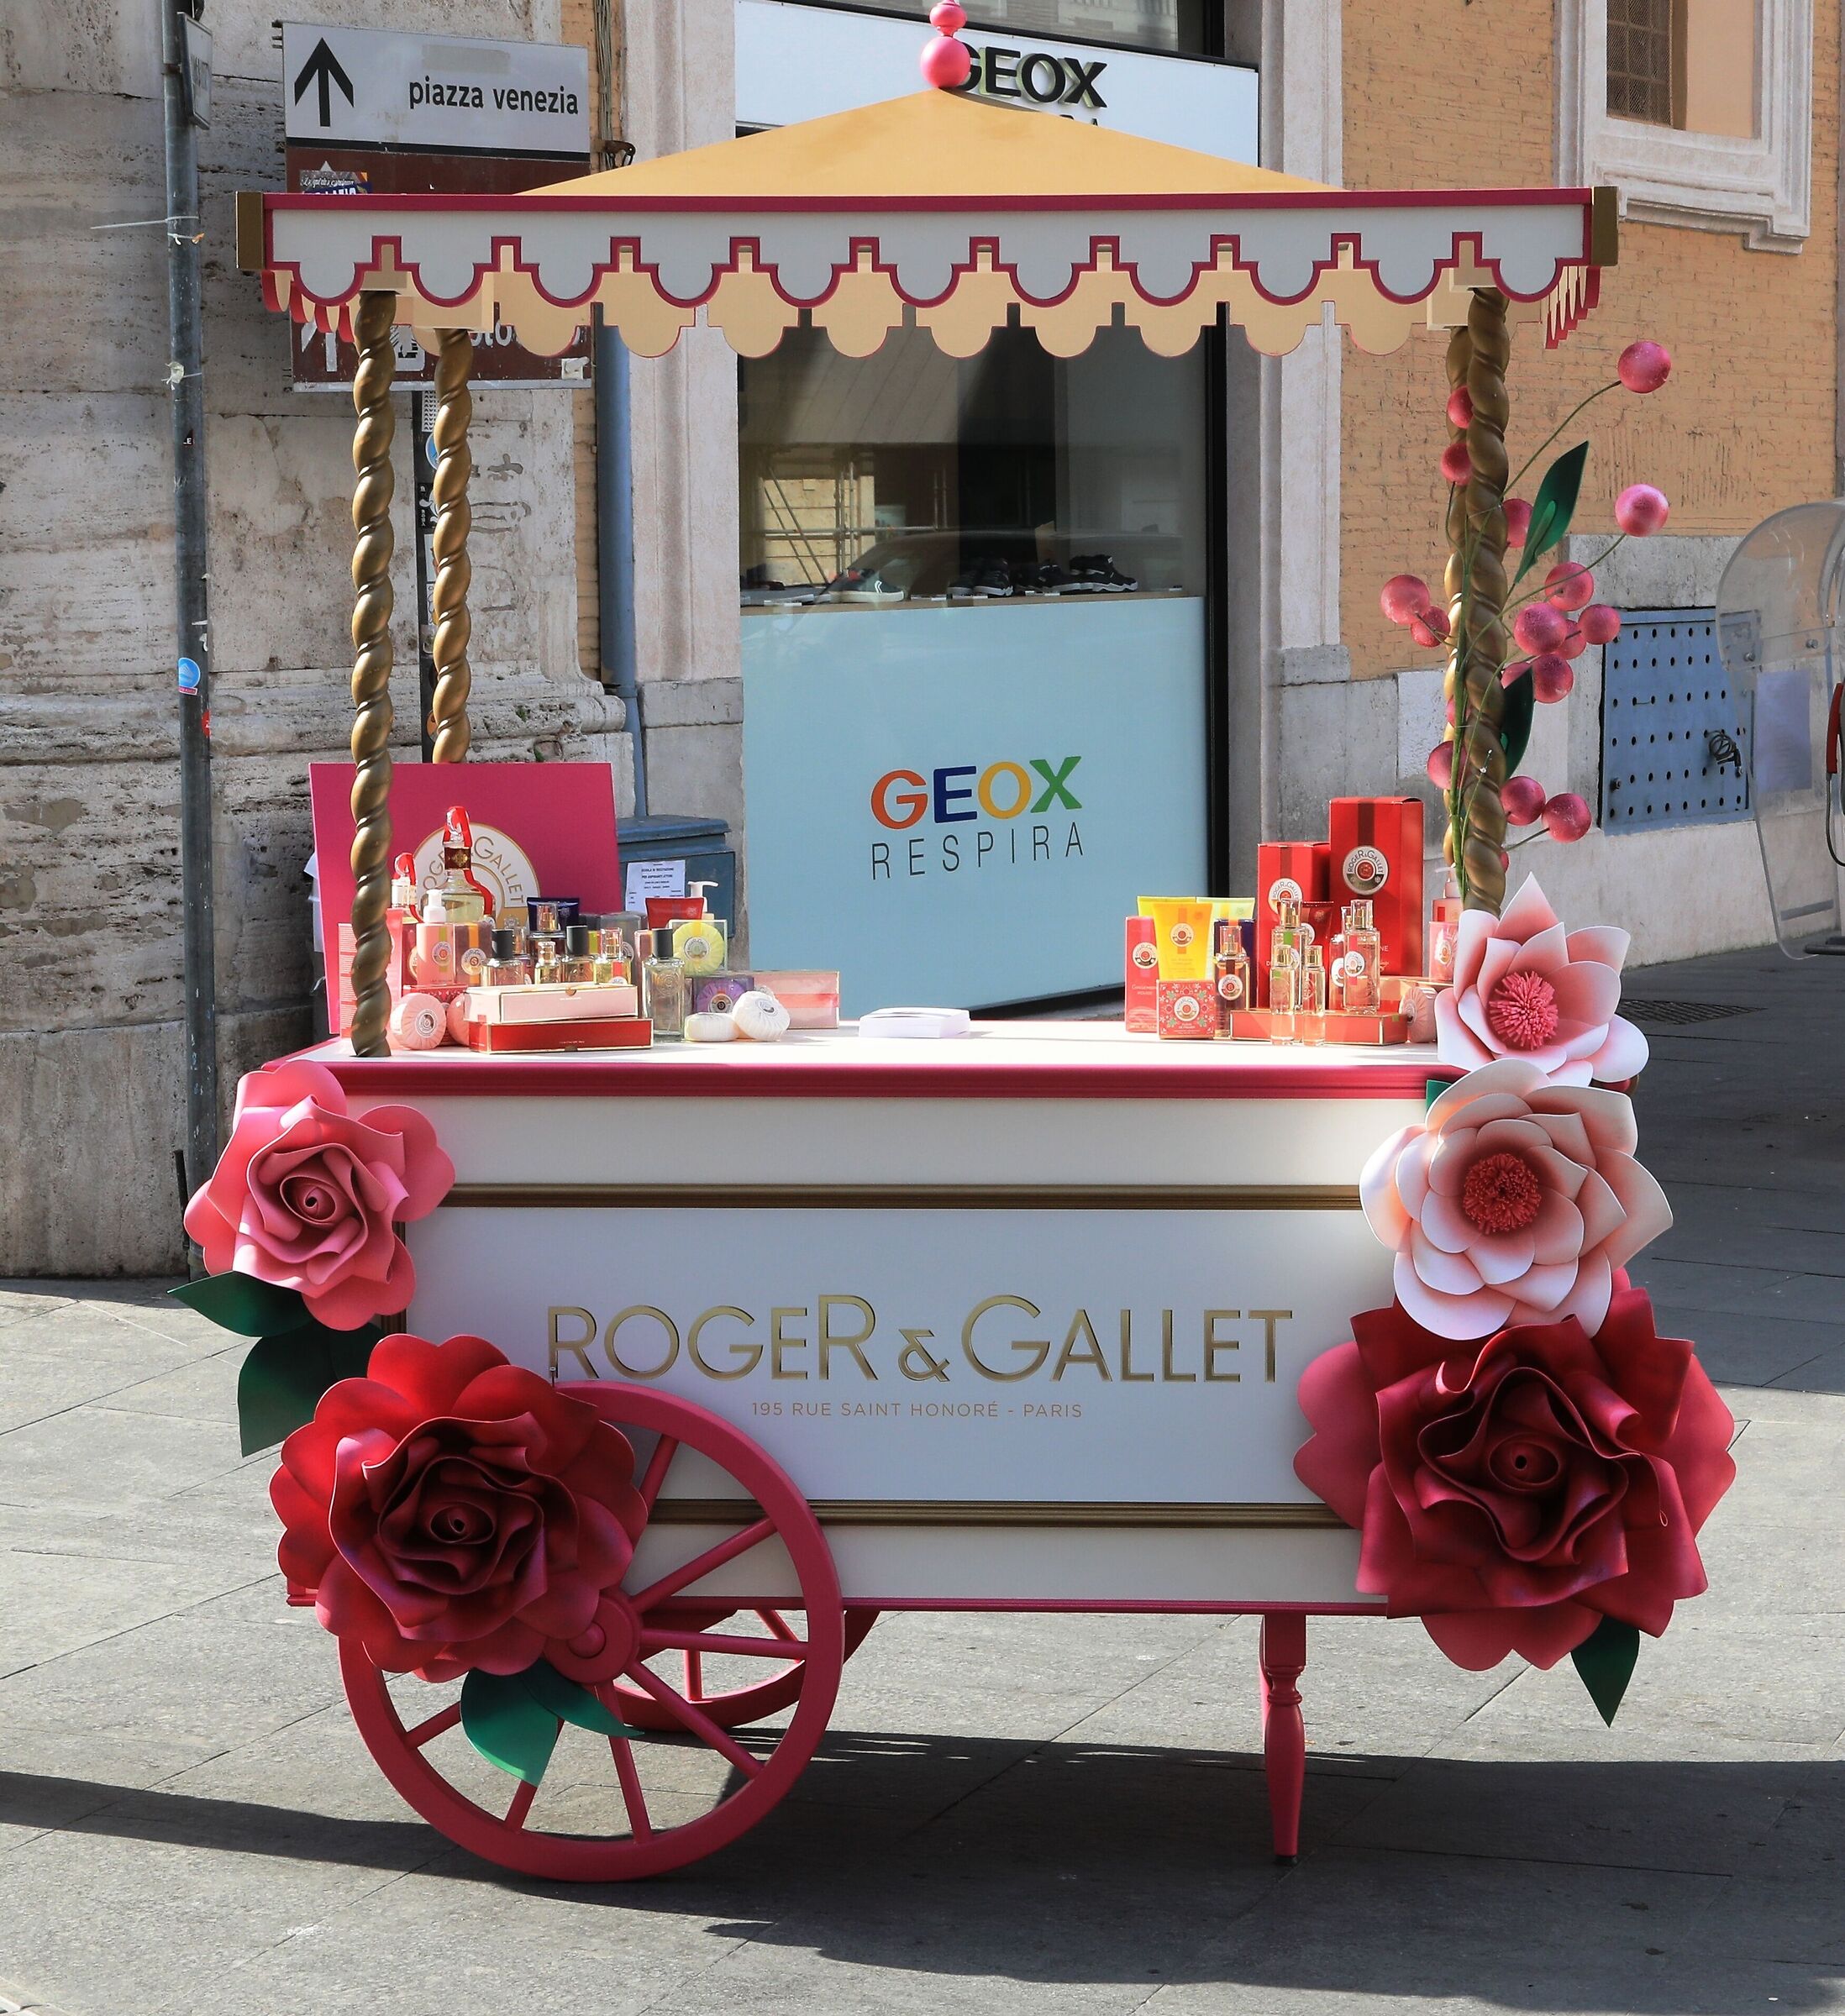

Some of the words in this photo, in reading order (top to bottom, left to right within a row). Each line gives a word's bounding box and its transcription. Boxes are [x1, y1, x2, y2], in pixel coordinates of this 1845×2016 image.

[409, 76, 484, 109] piazza
[493, 86, 579, 114] venezia
[870, 756, 1083, 830] GEOX
[474, 836, 524, 904] GALLET
[871, 821, 1084, 880] RESPIRA
[547, 1294, 879, 1381] ROGER
[898, 1328, 950, 1383] &
[961, 1294, 1293, 1383] GALLET
[752, 1402, 783, 1417] 195
[792, 1402, 832, 1417] RUE
[841, 1402, 901, 1417] SAINT
[911, 1400, 999, 1418] HONORÉ
[1023, 1404, 1082, 1419] PARIS
